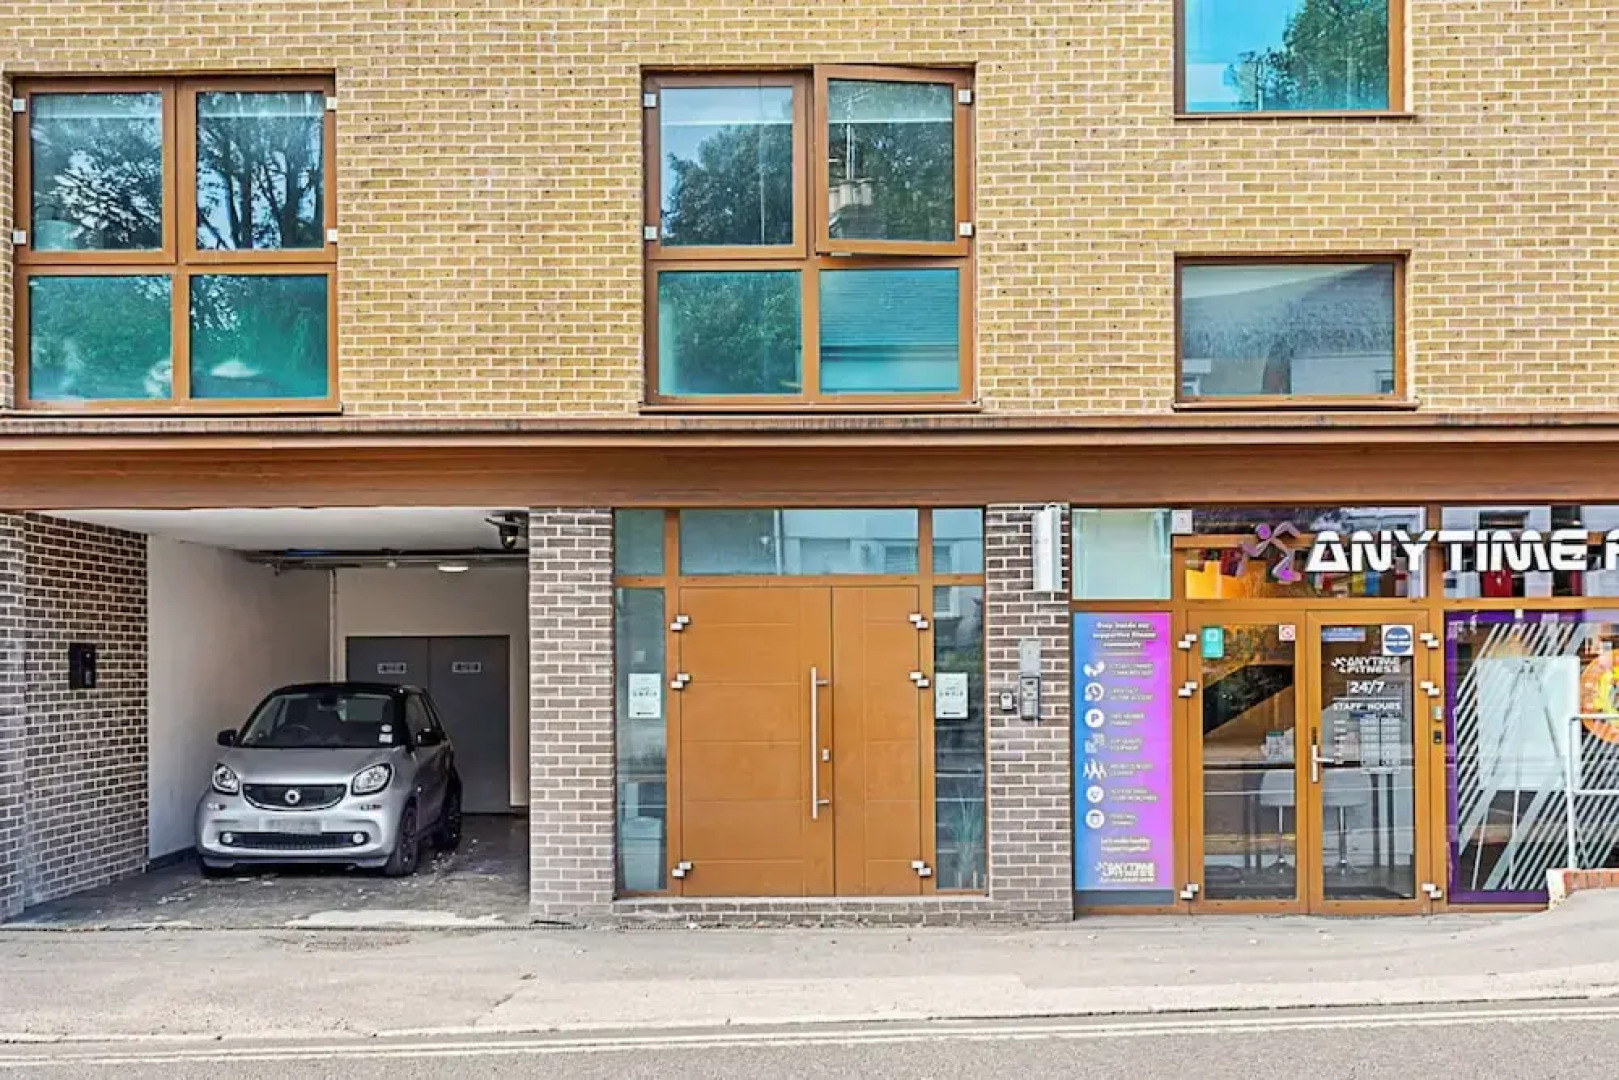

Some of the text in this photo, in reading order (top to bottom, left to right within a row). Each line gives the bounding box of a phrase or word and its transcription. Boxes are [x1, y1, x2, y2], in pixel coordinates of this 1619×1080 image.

[1305, 530, 1587, 571] ANYTIME
[1350, 680, 1385, 694] 24/7
[1333, 702, 1400, 711] STAFF HOURS
